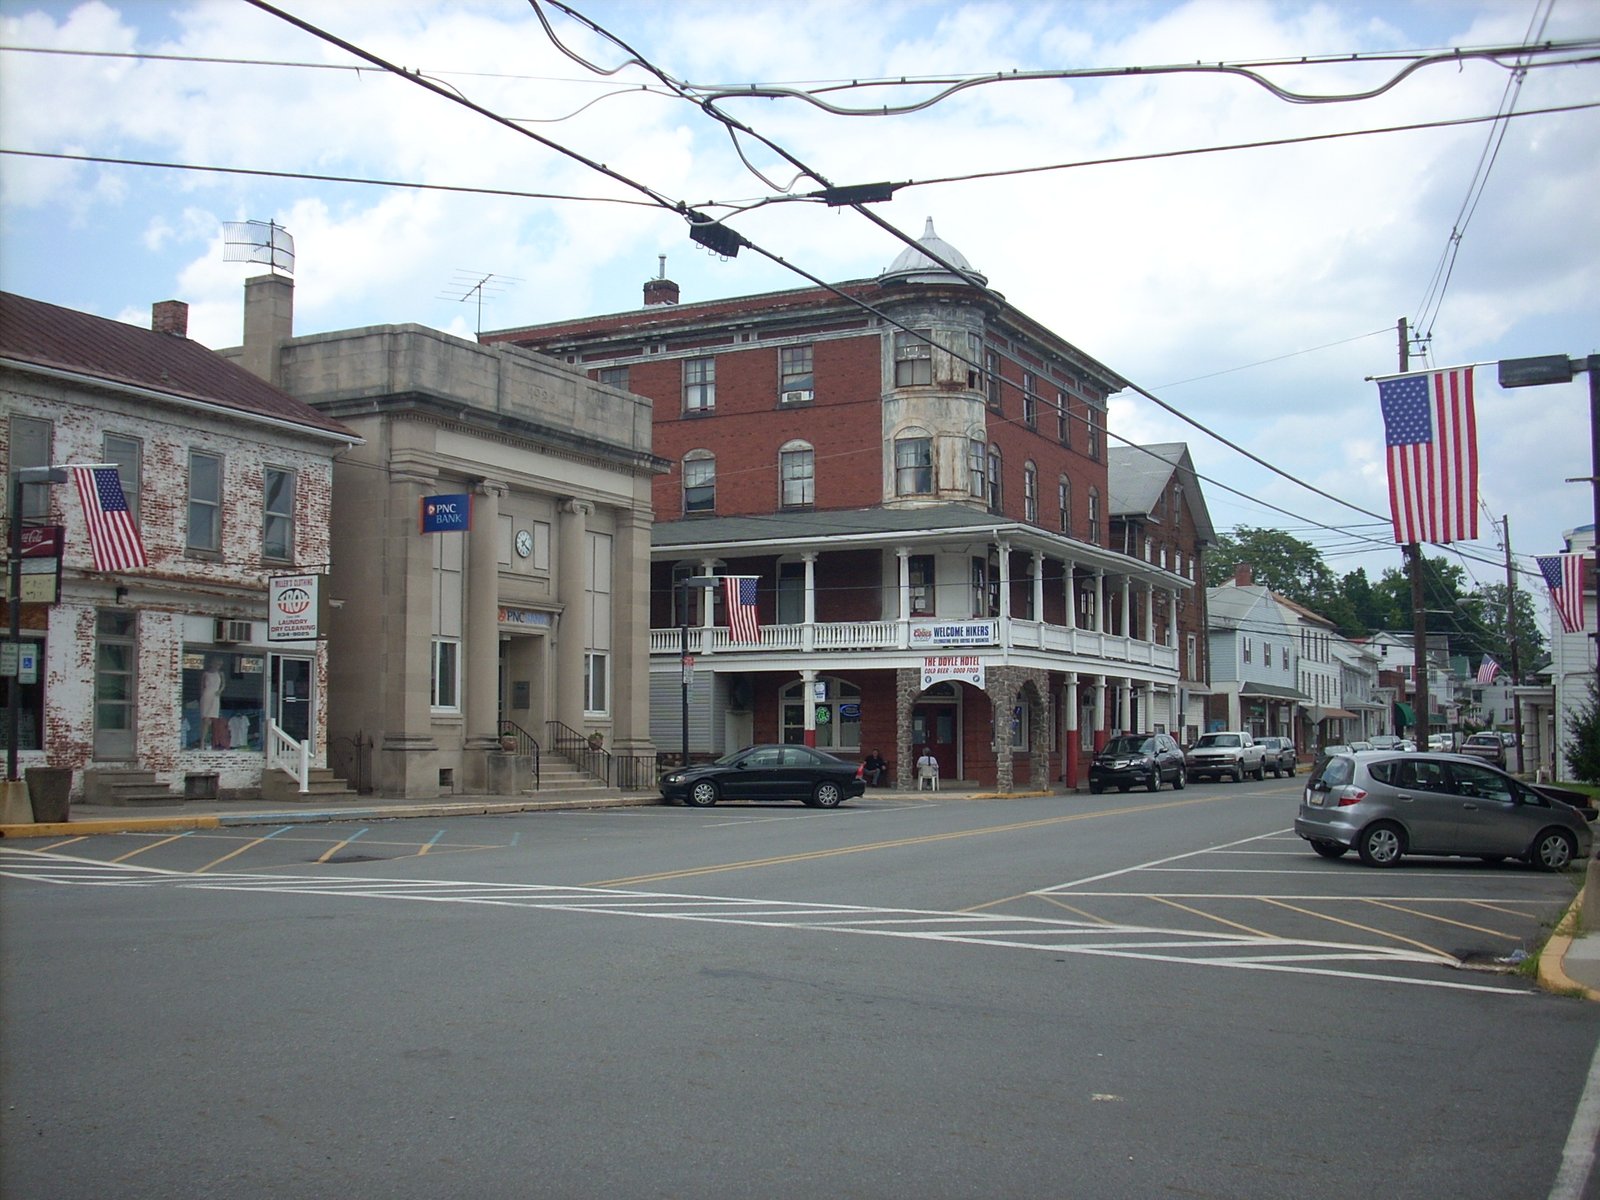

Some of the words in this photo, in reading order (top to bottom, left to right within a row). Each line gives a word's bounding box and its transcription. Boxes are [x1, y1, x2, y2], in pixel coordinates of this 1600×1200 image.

[436, 503, 457, 514] PNC
[436, 513, 462, 524] BANK
[279, 589, 309, 612] TROY
[507, 609, 525, 623] PNC
[284, 624, 316, 632] CLEANING
[934, 626, 963, 637] WELCOME
[966, 626, 989, 636] HIKERS
[925, 657, 936, 666] THE
[938, 657, 957, 666] DOYLE
[960, 656, 979, 665] HOTEL
